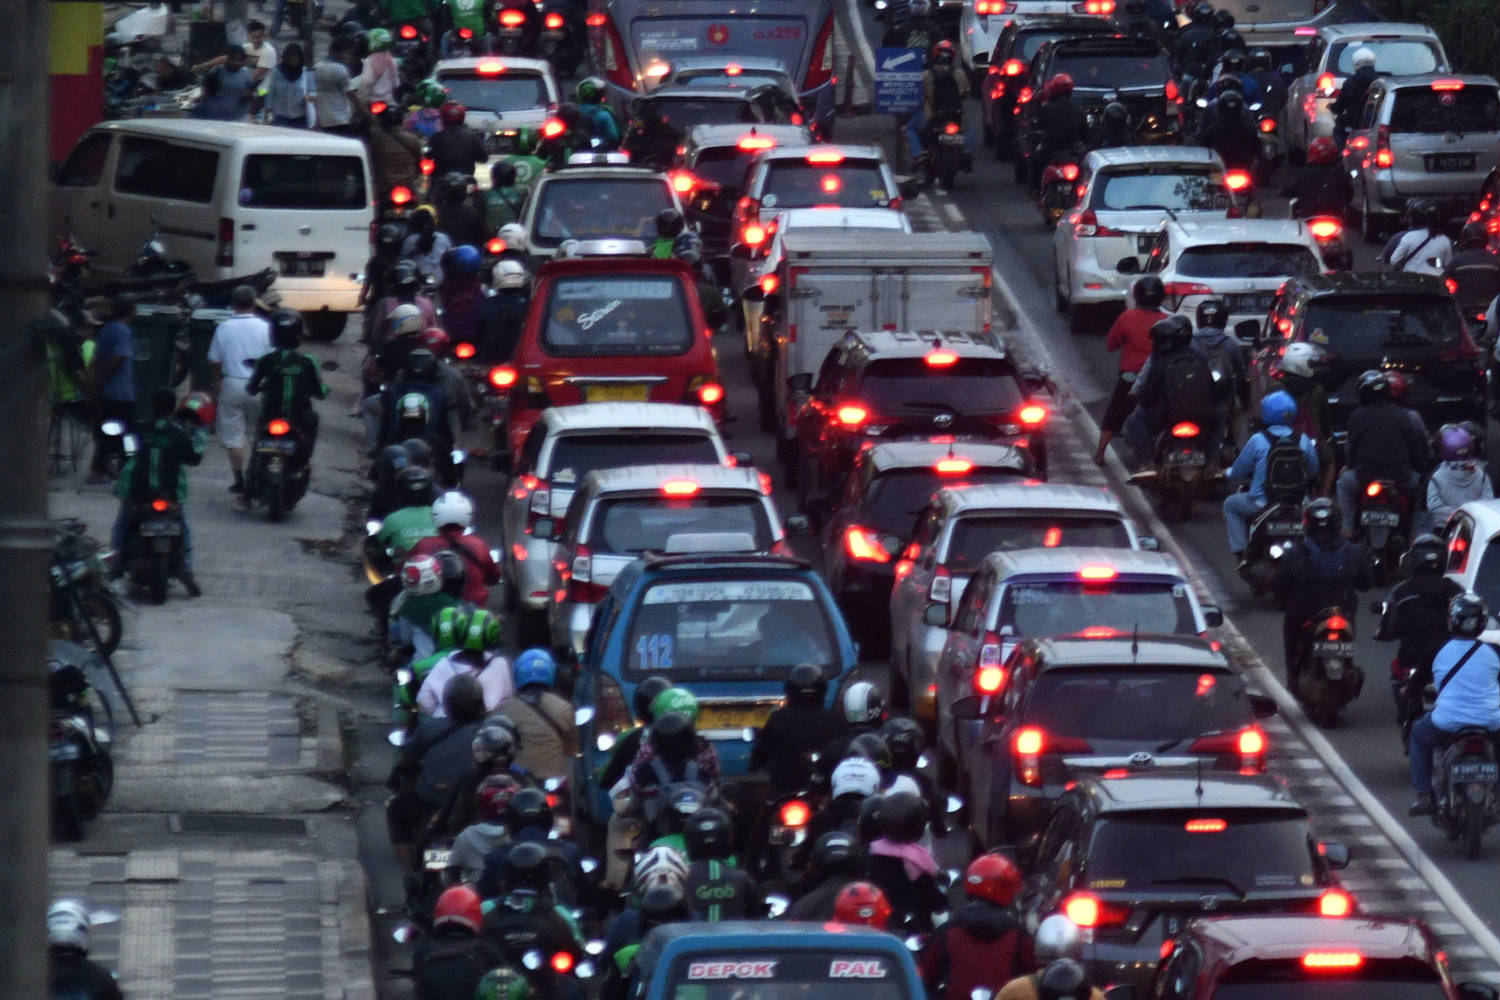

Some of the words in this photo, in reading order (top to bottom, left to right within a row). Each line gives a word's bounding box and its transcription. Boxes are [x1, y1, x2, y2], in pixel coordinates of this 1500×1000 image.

[636, 634, 673, 669] 112
[696, 884, 736, 899] Grab
[687, 960, 777, 980] DEPOK
[828, 960, 888, 979] PAL
